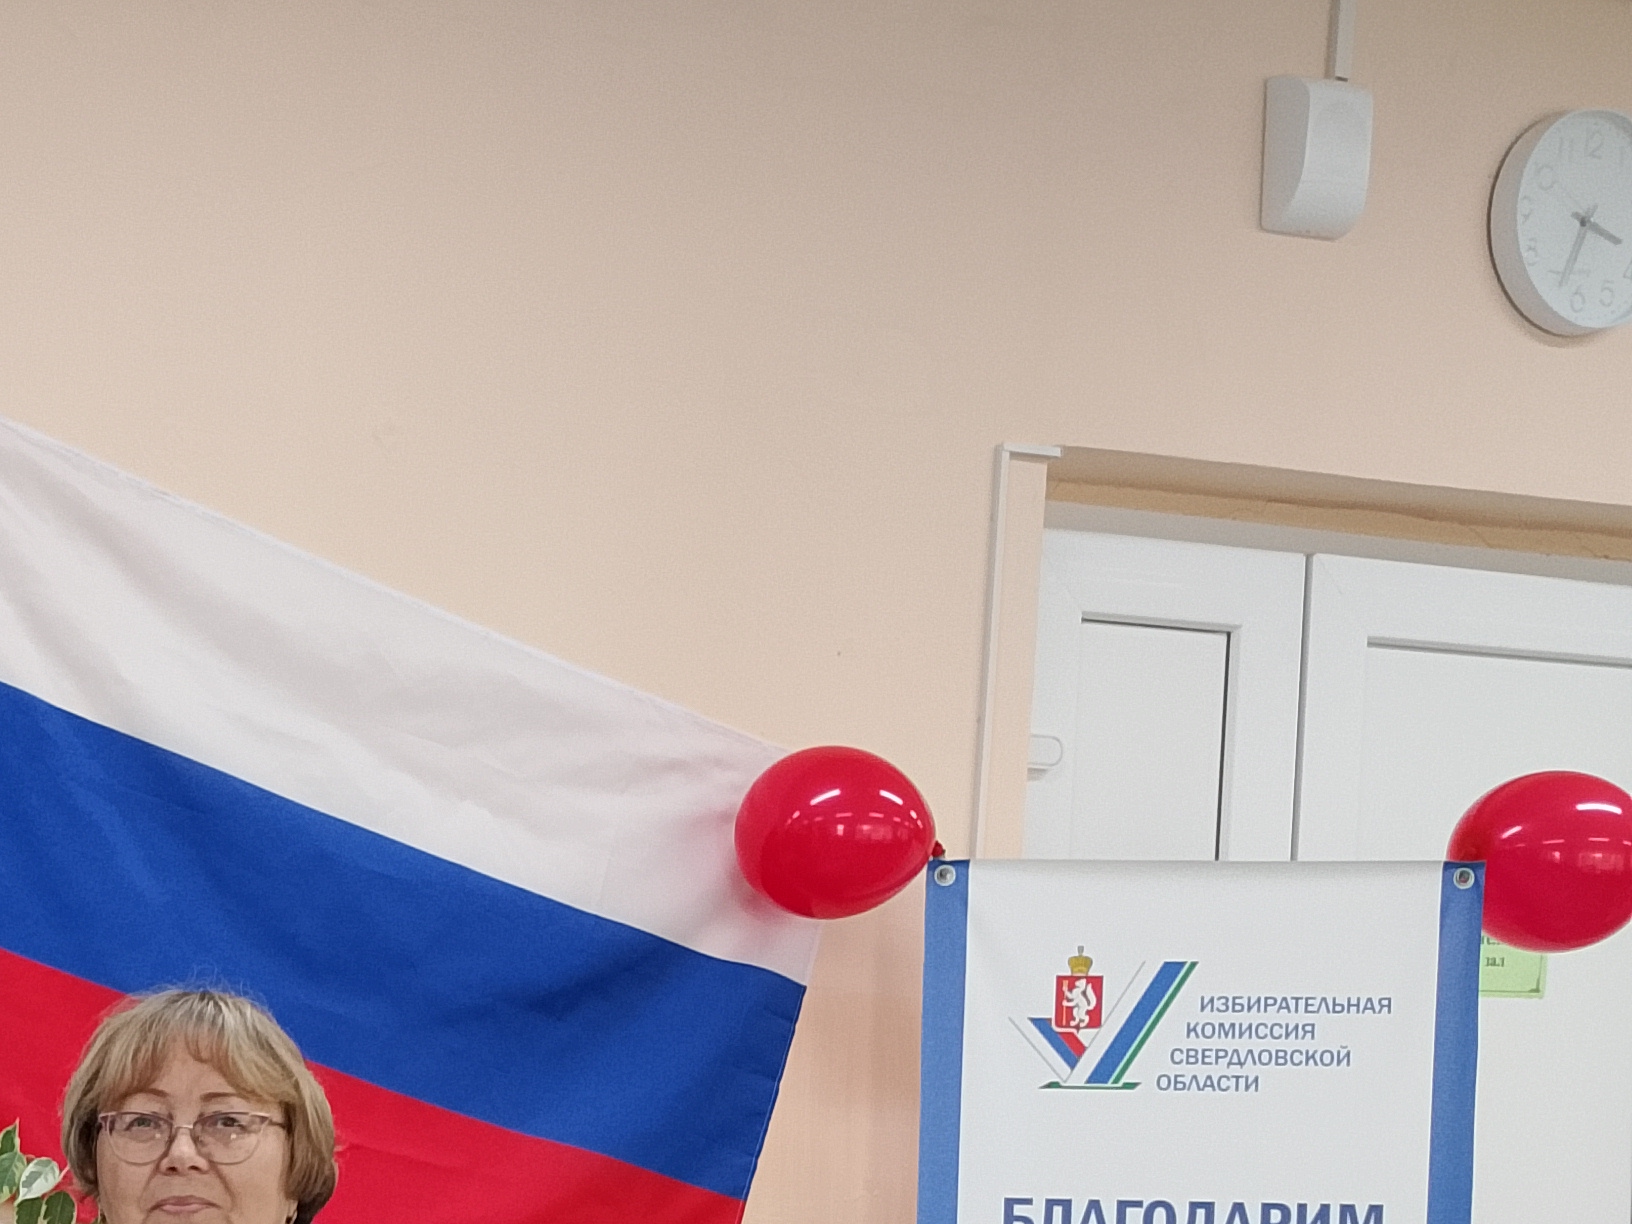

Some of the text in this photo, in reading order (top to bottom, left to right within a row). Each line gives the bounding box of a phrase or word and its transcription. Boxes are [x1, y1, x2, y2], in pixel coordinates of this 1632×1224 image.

[1199, 994, 1393, 1015] ИЗБИРАТЕЛЬНАЯ
[1185, 1021, 1316, 1041] КОМИССИЯ
[1169, 1045, 1352, 1070] СВЕРДЛОВСКОЙ
[1155, 1073, 1260, 1093] ОБЛАСТИ
